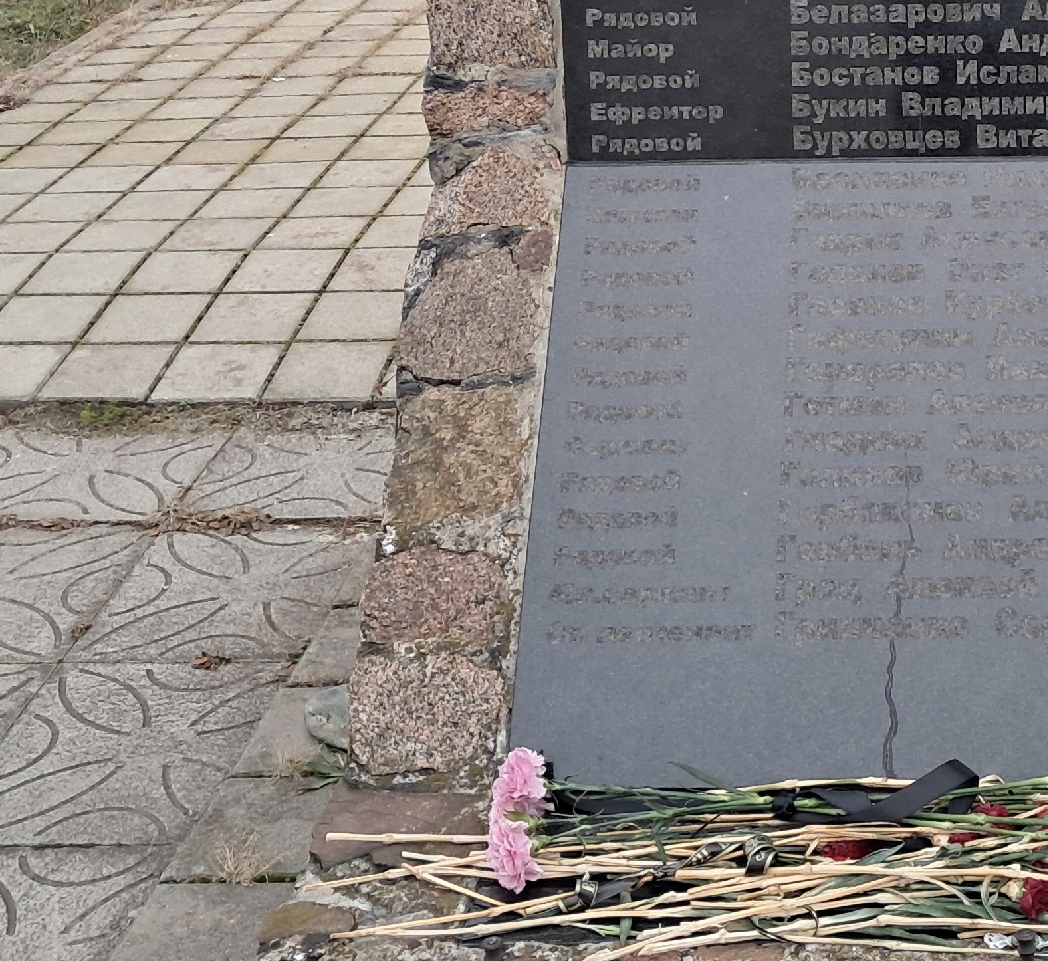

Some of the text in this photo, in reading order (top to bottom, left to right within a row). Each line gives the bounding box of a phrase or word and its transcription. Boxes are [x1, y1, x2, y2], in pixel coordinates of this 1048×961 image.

[585, 6, 698, 30] Рядовой
[789, 0, 1002, 28] Белазарович
[587, 38, 675, 64] Майор
[789, 30, 984, 60] Бондаренко
[588, 69, 701, 93] Рядовой
[790, 61, 940, 87] Бостанов
[791, 93, 888, 124] Букин
[591, 132, 702, 156] Рядовой
[792, 125, 962, 155] Бурховцев
